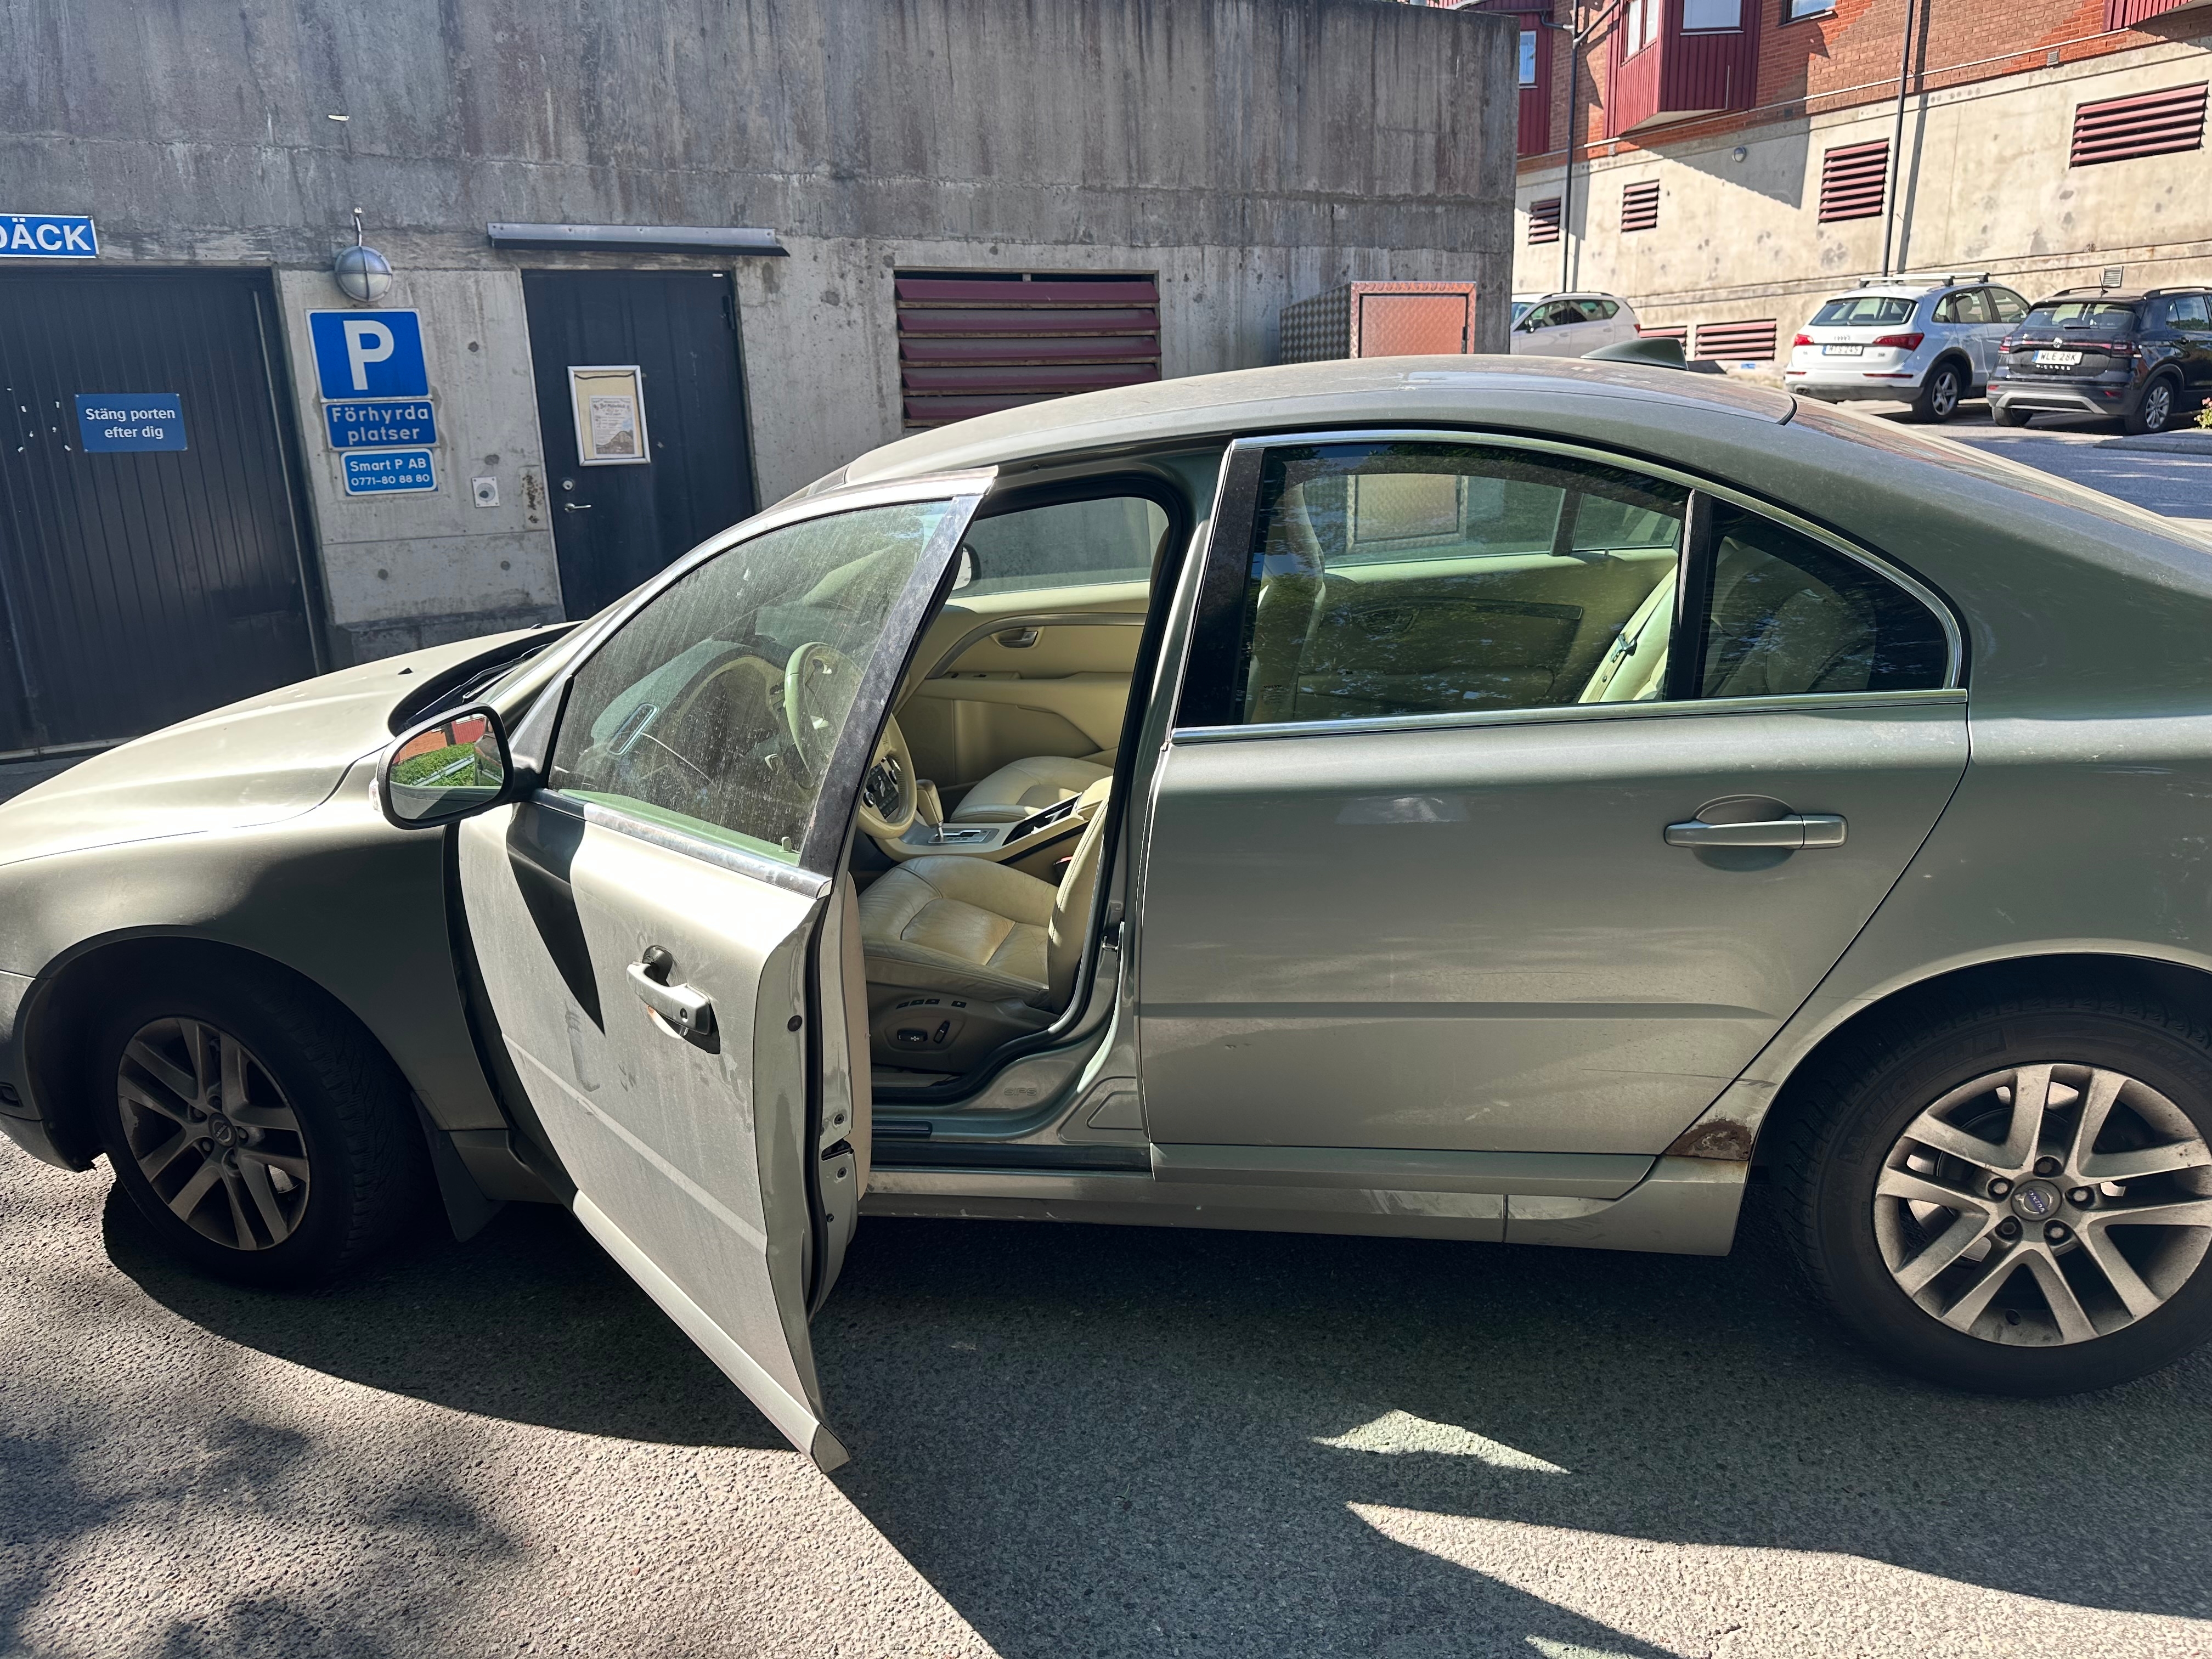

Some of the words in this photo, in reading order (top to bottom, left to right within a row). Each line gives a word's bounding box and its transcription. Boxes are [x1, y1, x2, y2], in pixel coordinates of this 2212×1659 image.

[343, 320, 394, 391] P
[2040, 352, 2057, 360] WLE
[2059, 353, 2077, 361] 28K
[86, 408, 127, 422] Stäng
[130, 408, 176, 422] porten
[331, 405, 429, 424] Förhyrda
[104, 426, 138, 438] efter
[142, 426, 163, 439] dig
[348, 426, 420, 445] platser
[349, 459, 391, 472] Smart
[394, 459, 404, 470] P
[408, 458, 426, 469] AB
[399, 475, 413, 483] 88
[415, 473, 430, 482] 80
[1860, 1030, 2001, 1132] MICHELIN
[1004, 1087, 1037, 1096] SIPS
[2028, 1189, 2046, 1213] VOLVO
